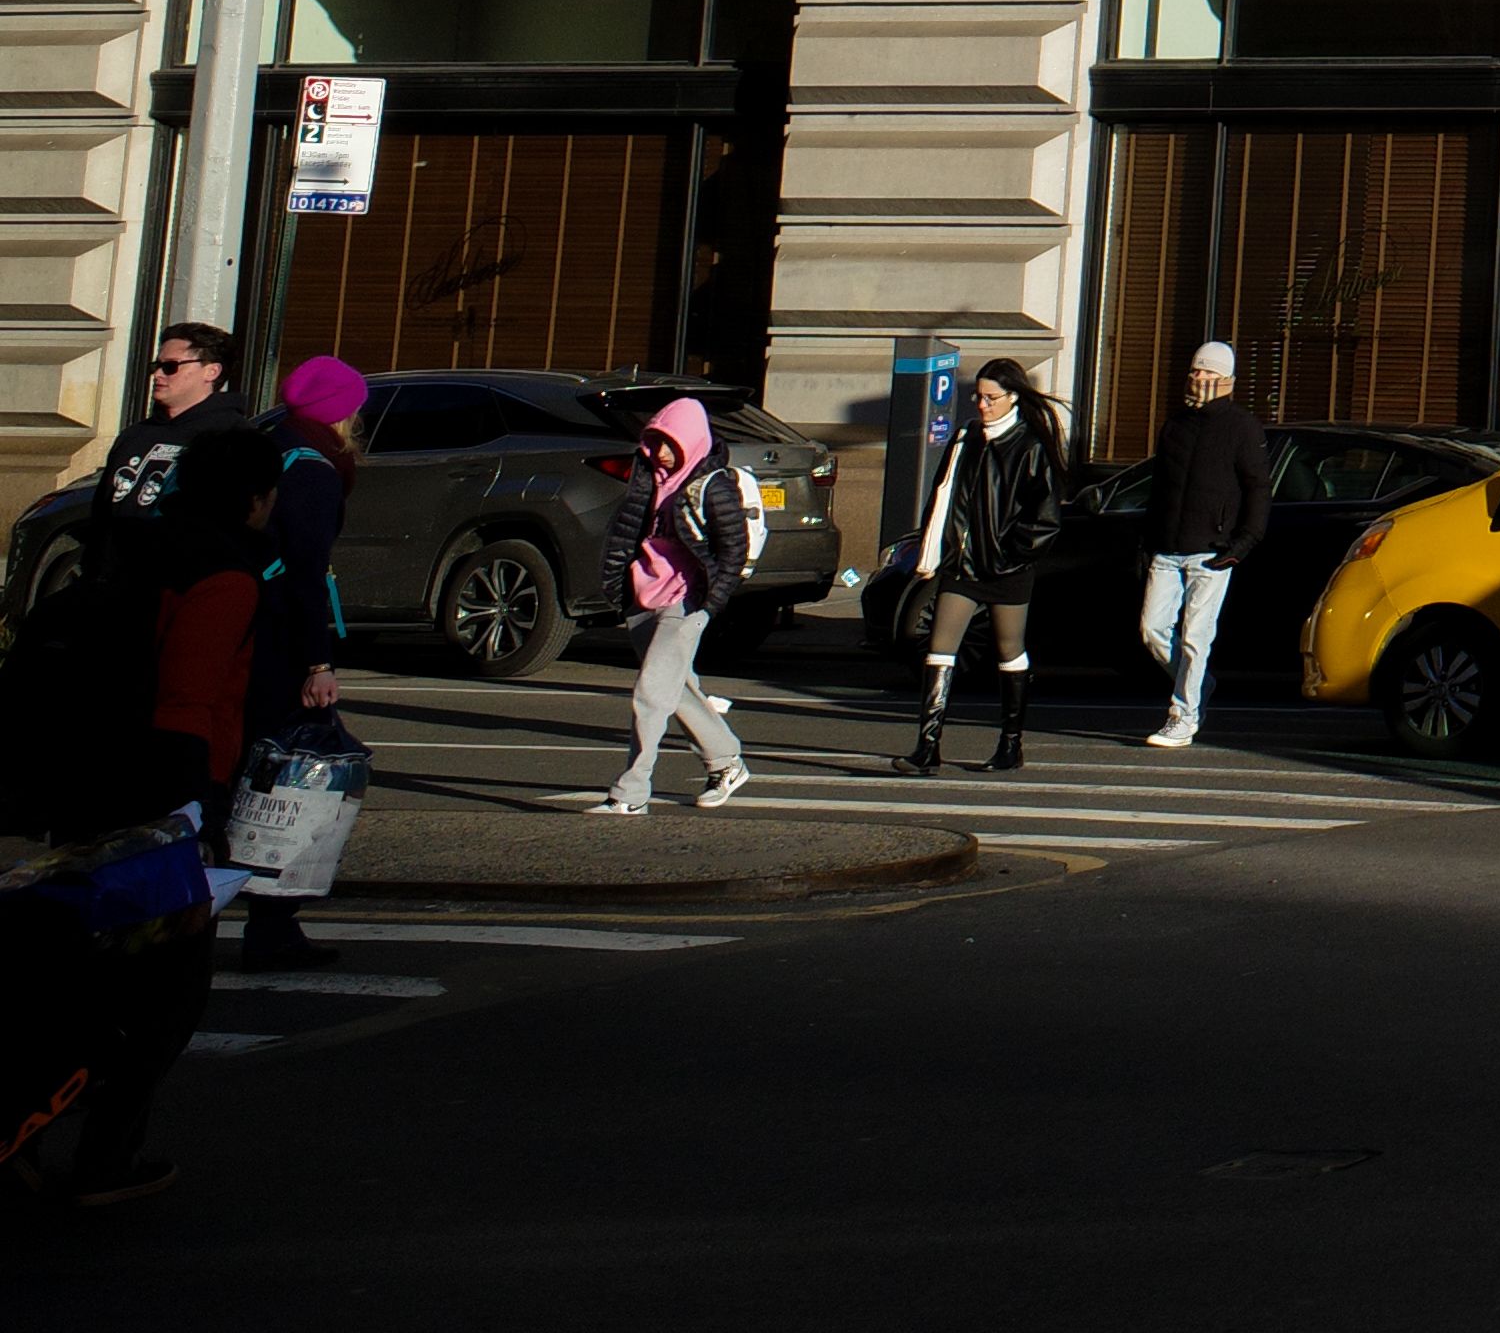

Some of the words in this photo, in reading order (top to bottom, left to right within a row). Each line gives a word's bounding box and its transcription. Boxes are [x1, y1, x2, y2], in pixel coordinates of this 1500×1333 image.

[305, 125, 320, 143] 2
[291, 196, 348, 211] 101473
[937, 375, 950, 401] P
[259, 796, 303, 816] DOWN
